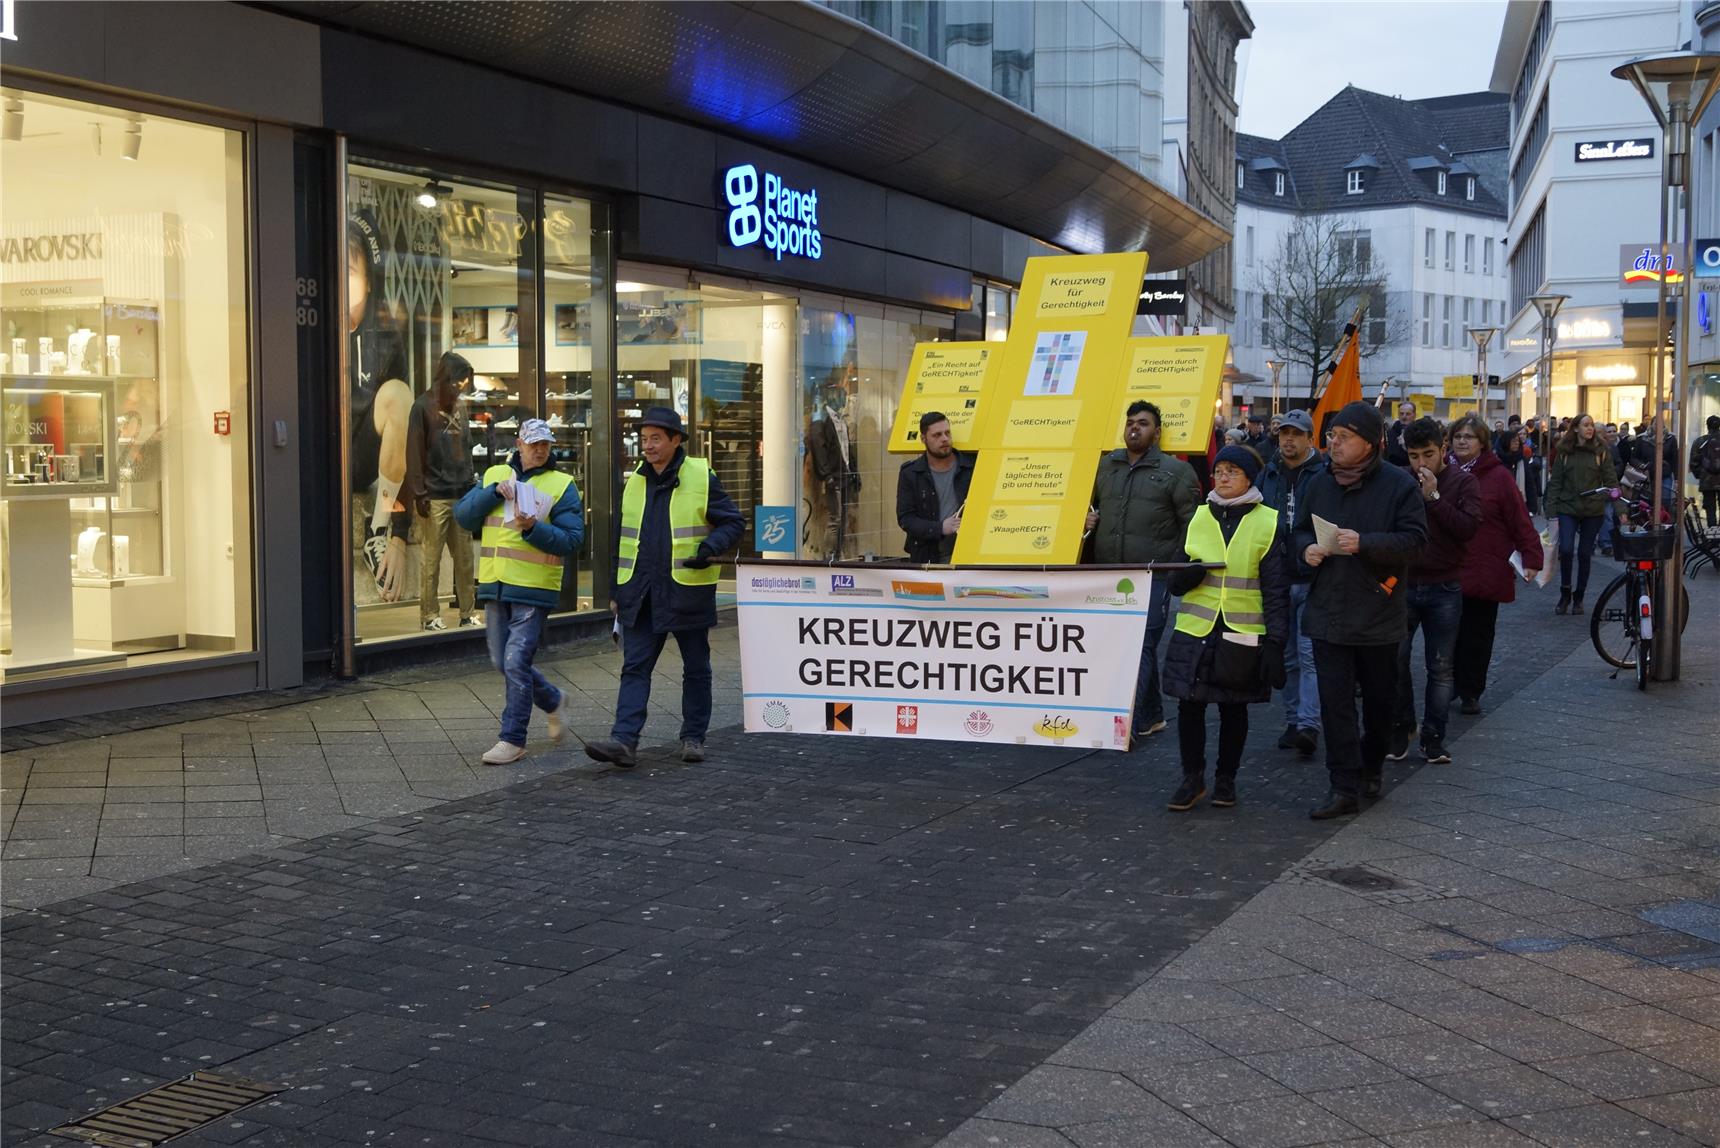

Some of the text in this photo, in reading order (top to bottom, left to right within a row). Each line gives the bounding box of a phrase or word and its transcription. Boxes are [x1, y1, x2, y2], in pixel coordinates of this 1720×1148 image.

[765, 173, 817, 225] Planet
[764, 207, 822, 260] Sports
[368, 236, 381, 264] STAY
[297, 277, 318, 297] 68
[1050, 277, 1106, 287] Kreuzweg
[20, 286, 73, 296] COOL ROMANCE
[1040, 300, 1105, 310] Gerechtigkeit
[296, 309, 318, 326] 80
[968, 360, 982, 368] auf
[1175, 358, 1198, 366] durch
[1005, 471, 1063, 480] tägliches Brot
[1002, 481, 1016, 489] gib
[834, 576, 852, 587] ALZ
[798, 616, 1086, 653] KREUZWEG FÜR
[798, 658, 1088, 697] GERECHTIGKEIT
[766, 700, 790, 718] EMMAUS
[1041, 713, 1075, 735] kfd
